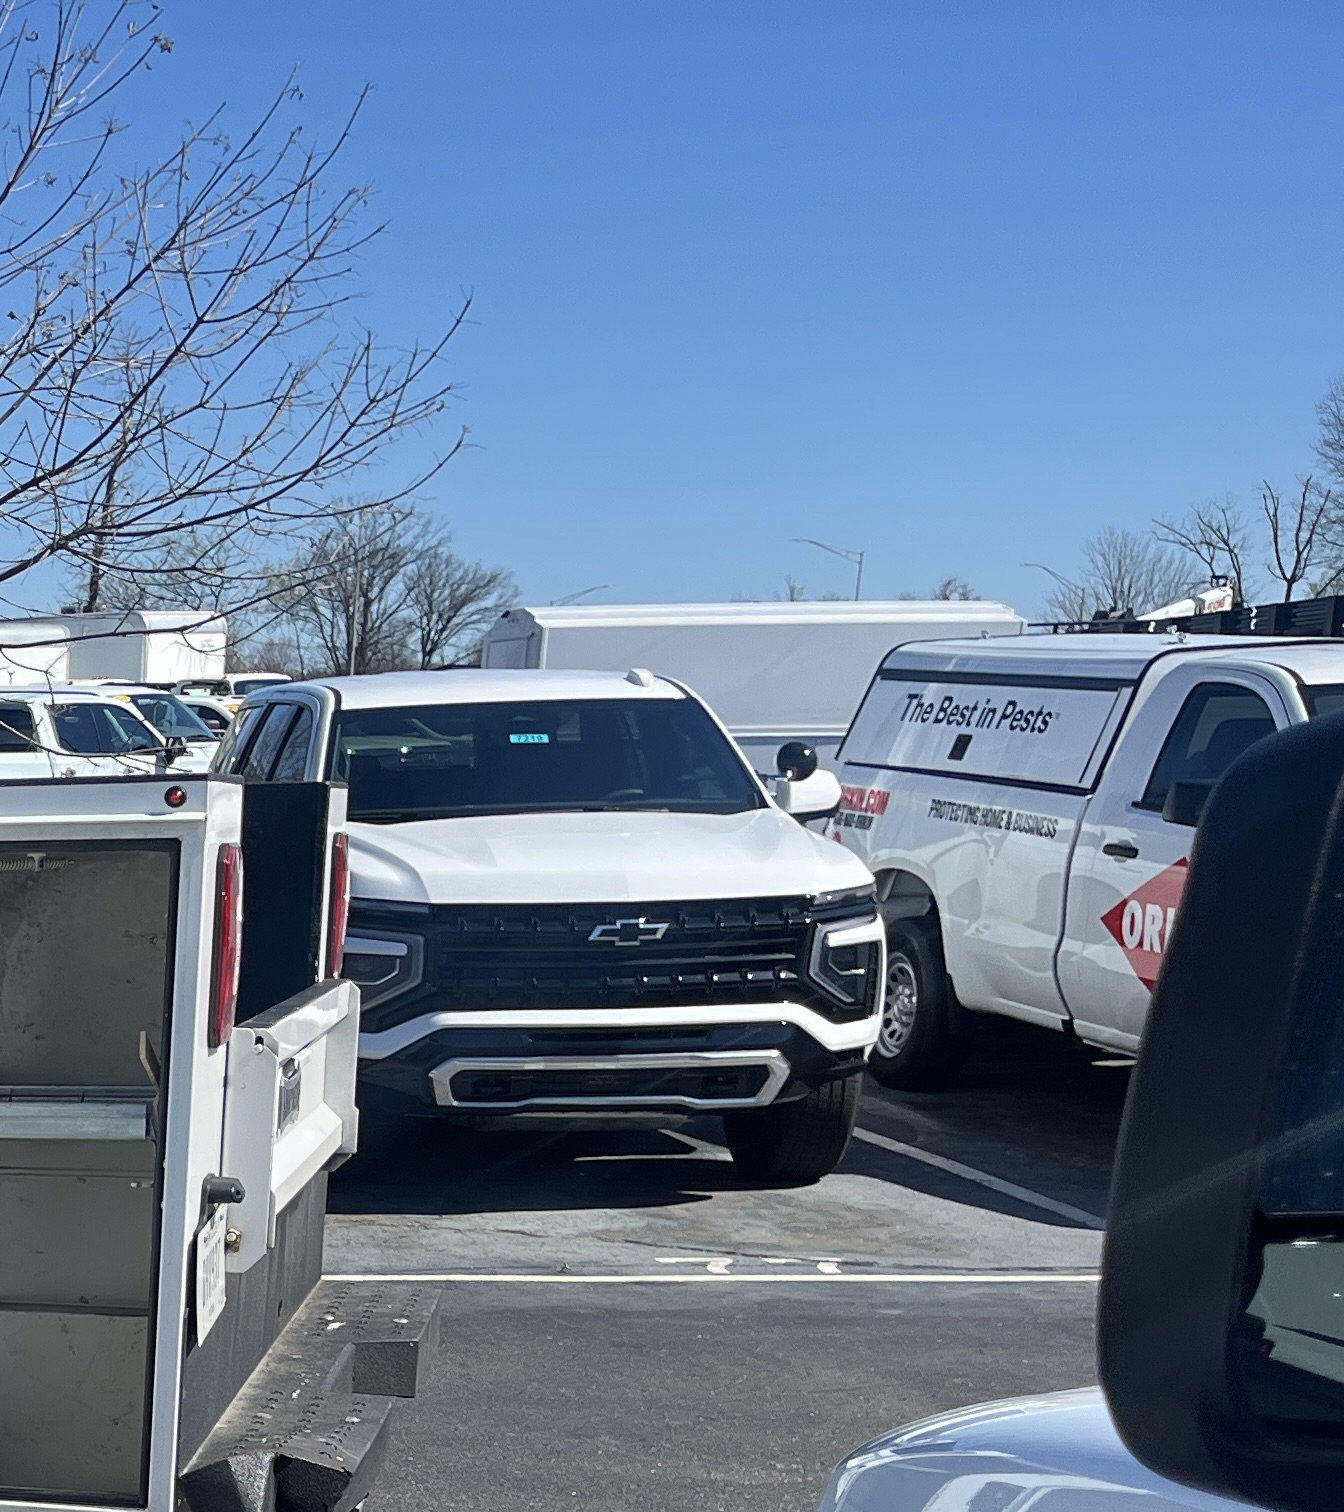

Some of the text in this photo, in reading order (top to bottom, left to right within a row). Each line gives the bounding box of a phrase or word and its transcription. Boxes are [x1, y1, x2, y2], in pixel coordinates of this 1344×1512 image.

[900, 693, 1053, 734] The Best in Pests
[928, 798, 981, 826] PROTECTING
[978, 807, 1007, 829] HOME
[1011, 812, 1059, 839] BUSINESS
